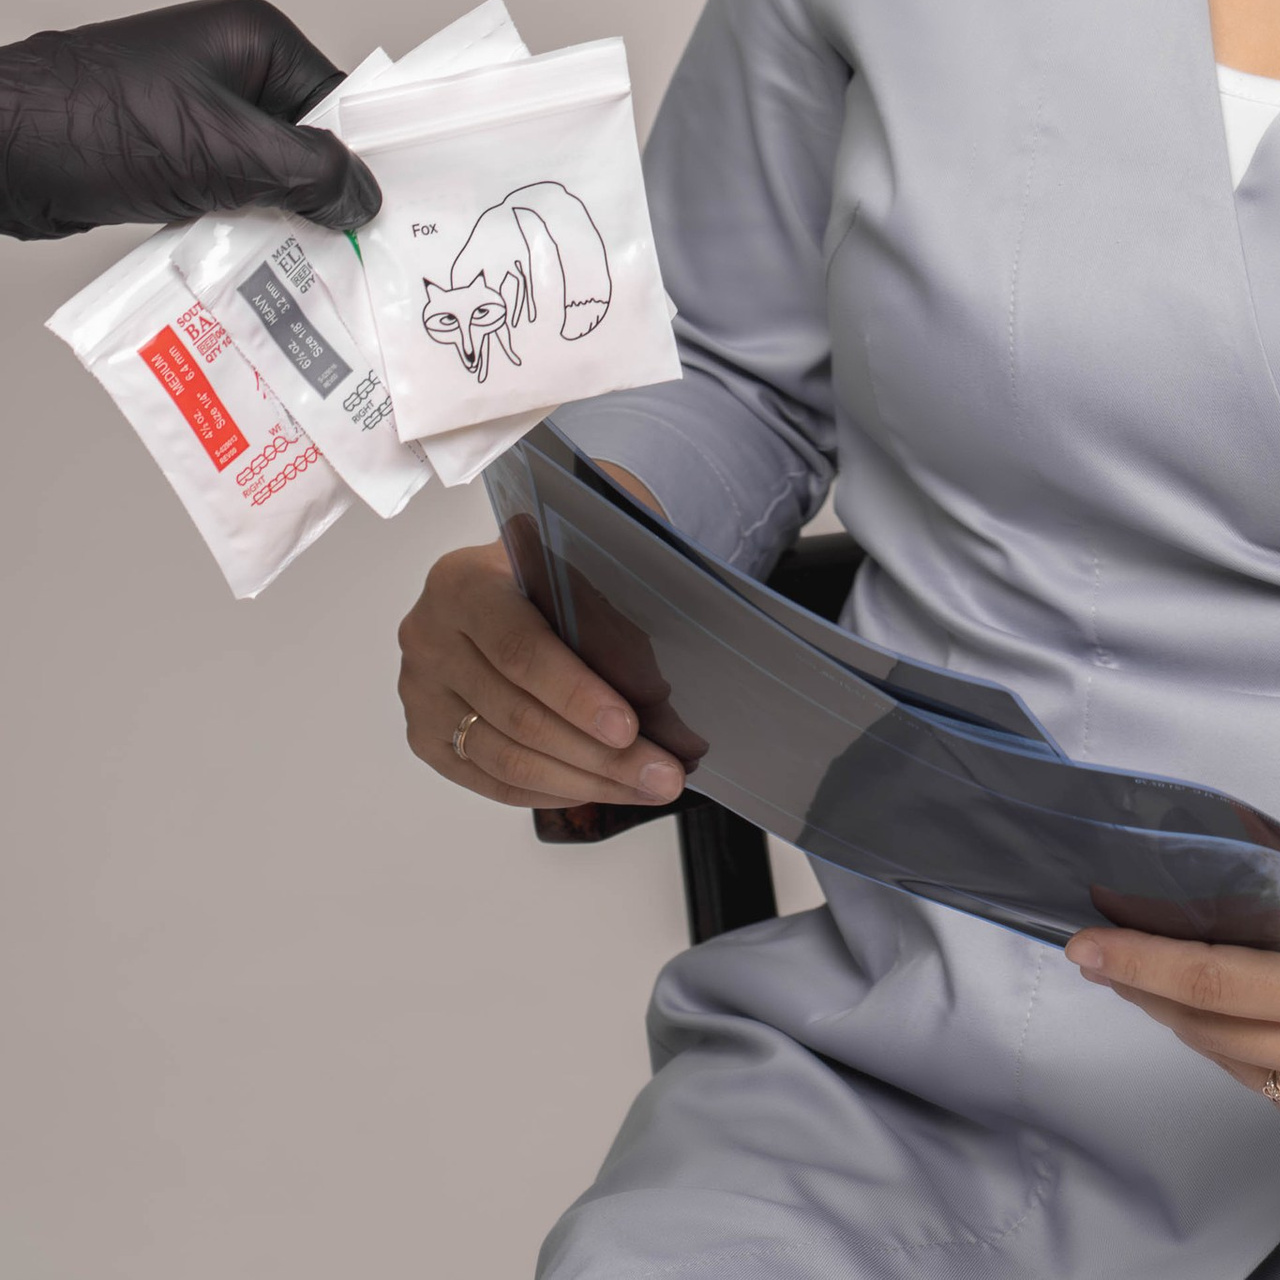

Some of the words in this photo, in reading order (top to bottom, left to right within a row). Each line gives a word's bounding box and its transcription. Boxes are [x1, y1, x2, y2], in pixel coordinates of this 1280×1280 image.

[411, 223, 438, 238] Fox
[266, 281, 281, 299] mm
[300, 274, 316, 294] QTY
[253, 294, 278, 326] HEAVY
[277, 296, 290, 314] 3.2
[291, 322, 307, 339] 1/8"
[169, 345, 185, 365] mm
[206, 344, 222, 364] QTY
[306, 335, 324, 358] Size
[152, 353, 185, 396] MEDIUM
[180, 363, 195, 381] 6.4
[197, 392, 212, 409] 1/4"
[211, 406, 226, 430] Size
[352, 399, 375, 424] RIGHT
[243, 474, 266, 499] RIGHT
